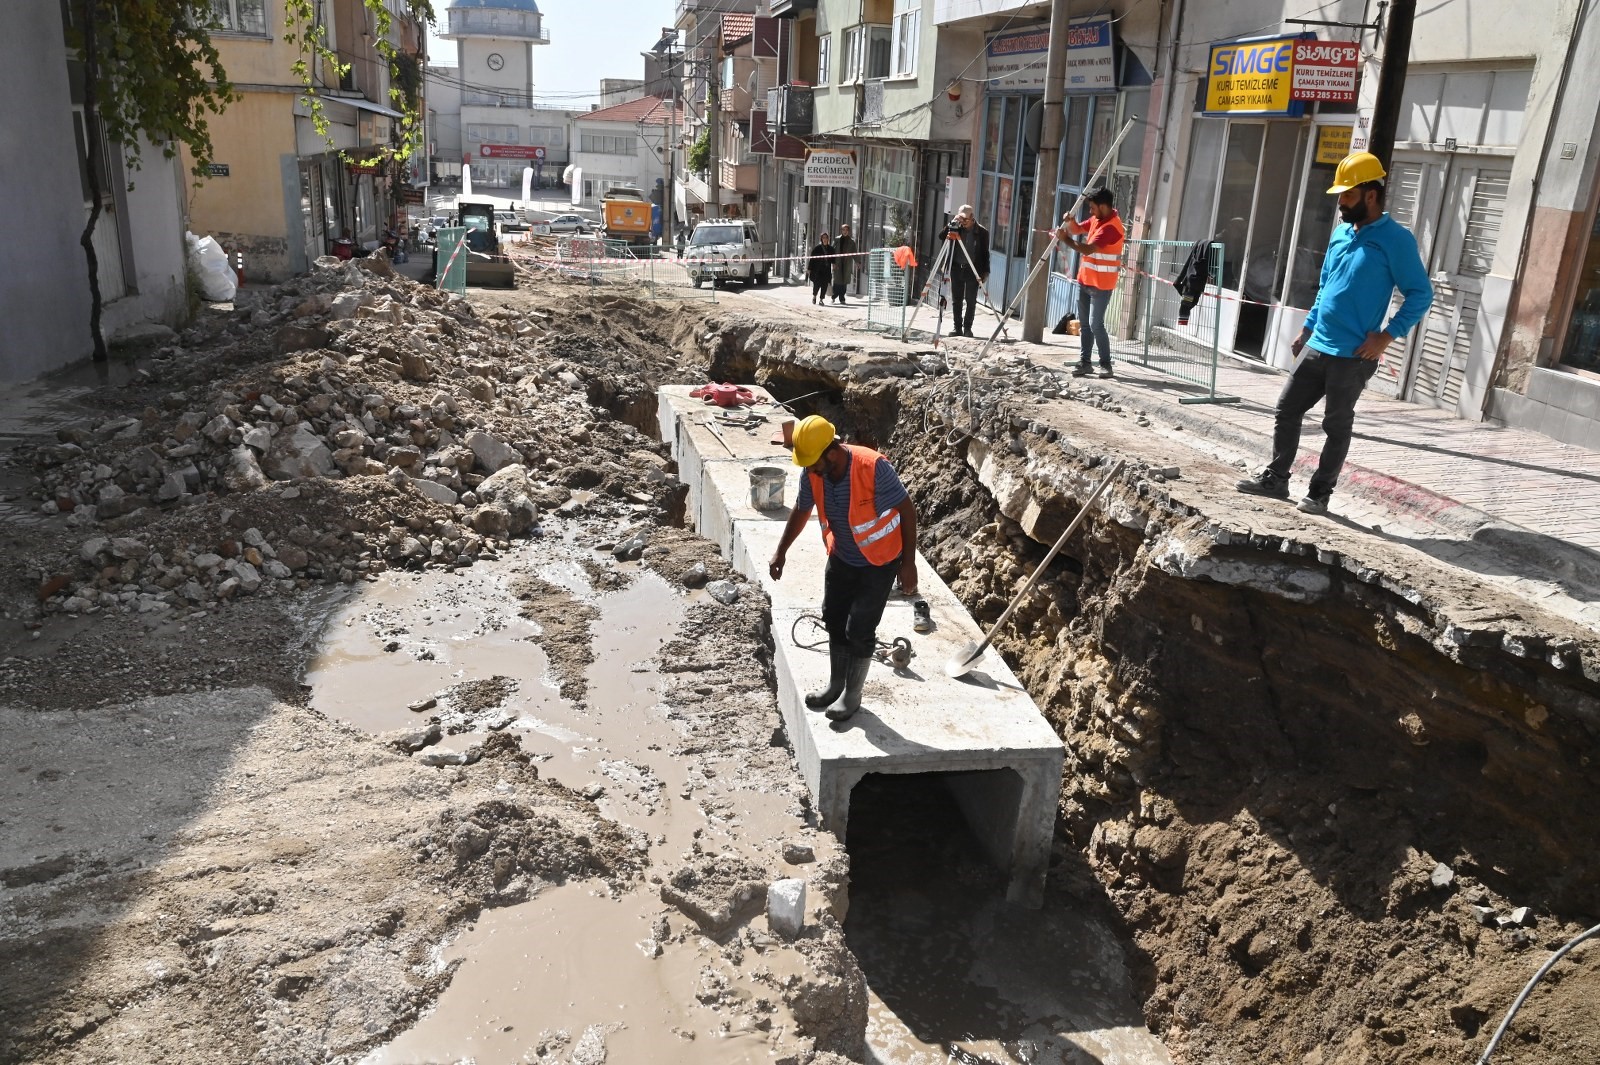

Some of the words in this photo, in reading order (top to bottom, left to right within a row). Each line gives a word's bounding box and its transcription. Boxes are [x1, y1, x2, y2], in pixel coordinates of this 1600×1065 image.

[1296, 68, 1315, 76] KURU
[1316, 68, 1353, 77] TEMİZLEME
[1216, 80, 1235, 91] KURU
[1236, 78, 1279, 91] TEMİZLEME
[1298, 79, 1325, 87] ÇAMAŞIR
[1326, 79, 1350, 87] YIKAMA
[1217, 95, 1246, 106] ÇAMAŞIR
[1247, 94, 1273, 105] YIKAMA
[1294, 90, 1300, 98] 0
[1301, 90, 1315, 98] 535
[1316, 91, 1331, 99] 285
[1332, 91, 1342, 99] 21
[1343, 92, 1353, 100] 31
[811, 155, 850, 165] PERDECİ
[807, 166, 854, 175] ERCÜMENT
